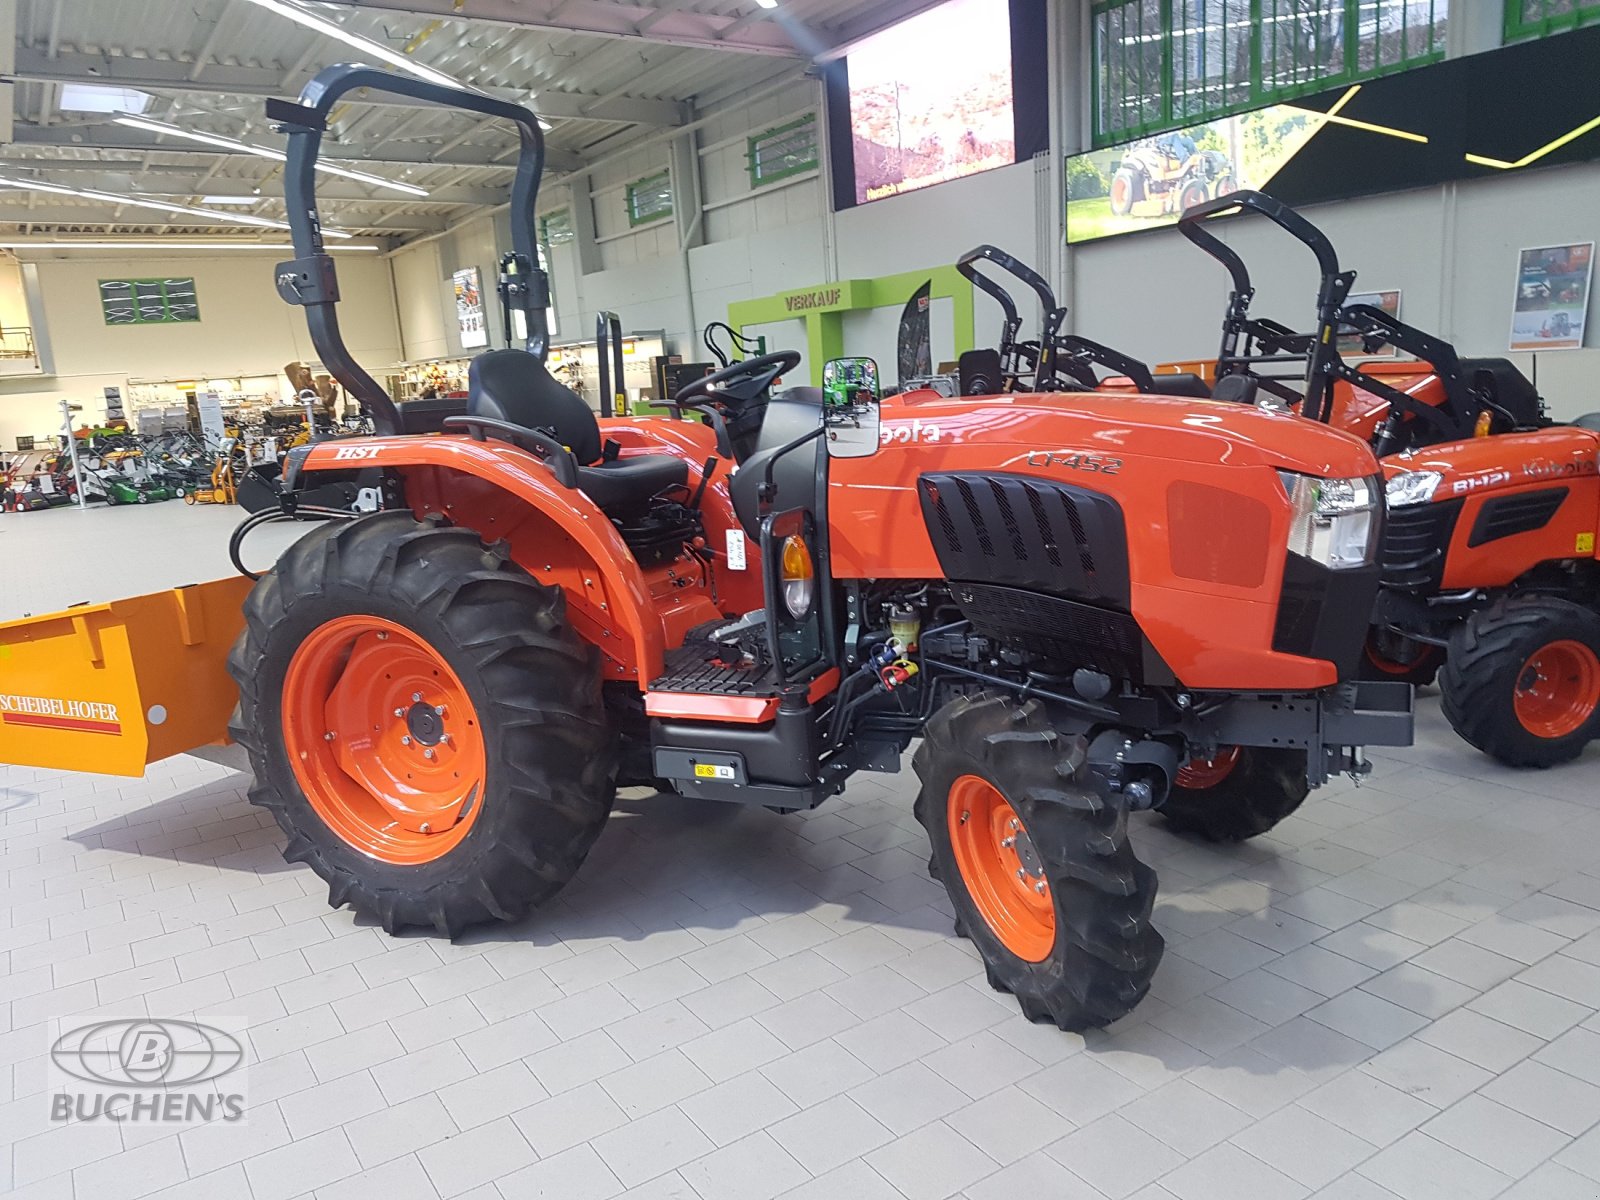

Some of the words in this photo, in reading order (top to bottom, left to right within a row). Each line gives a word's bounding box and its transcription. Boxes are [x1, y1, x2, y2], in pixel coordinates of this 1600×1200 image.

[784, 288, 841, 311] VERKAUF
[880, 419, 940, 445] bota
[334, 445, 386, 460] HST
[1452, 471, 1511, 494] B1-121
[0, 694, 120, 721] SCHEIBELHOFER
